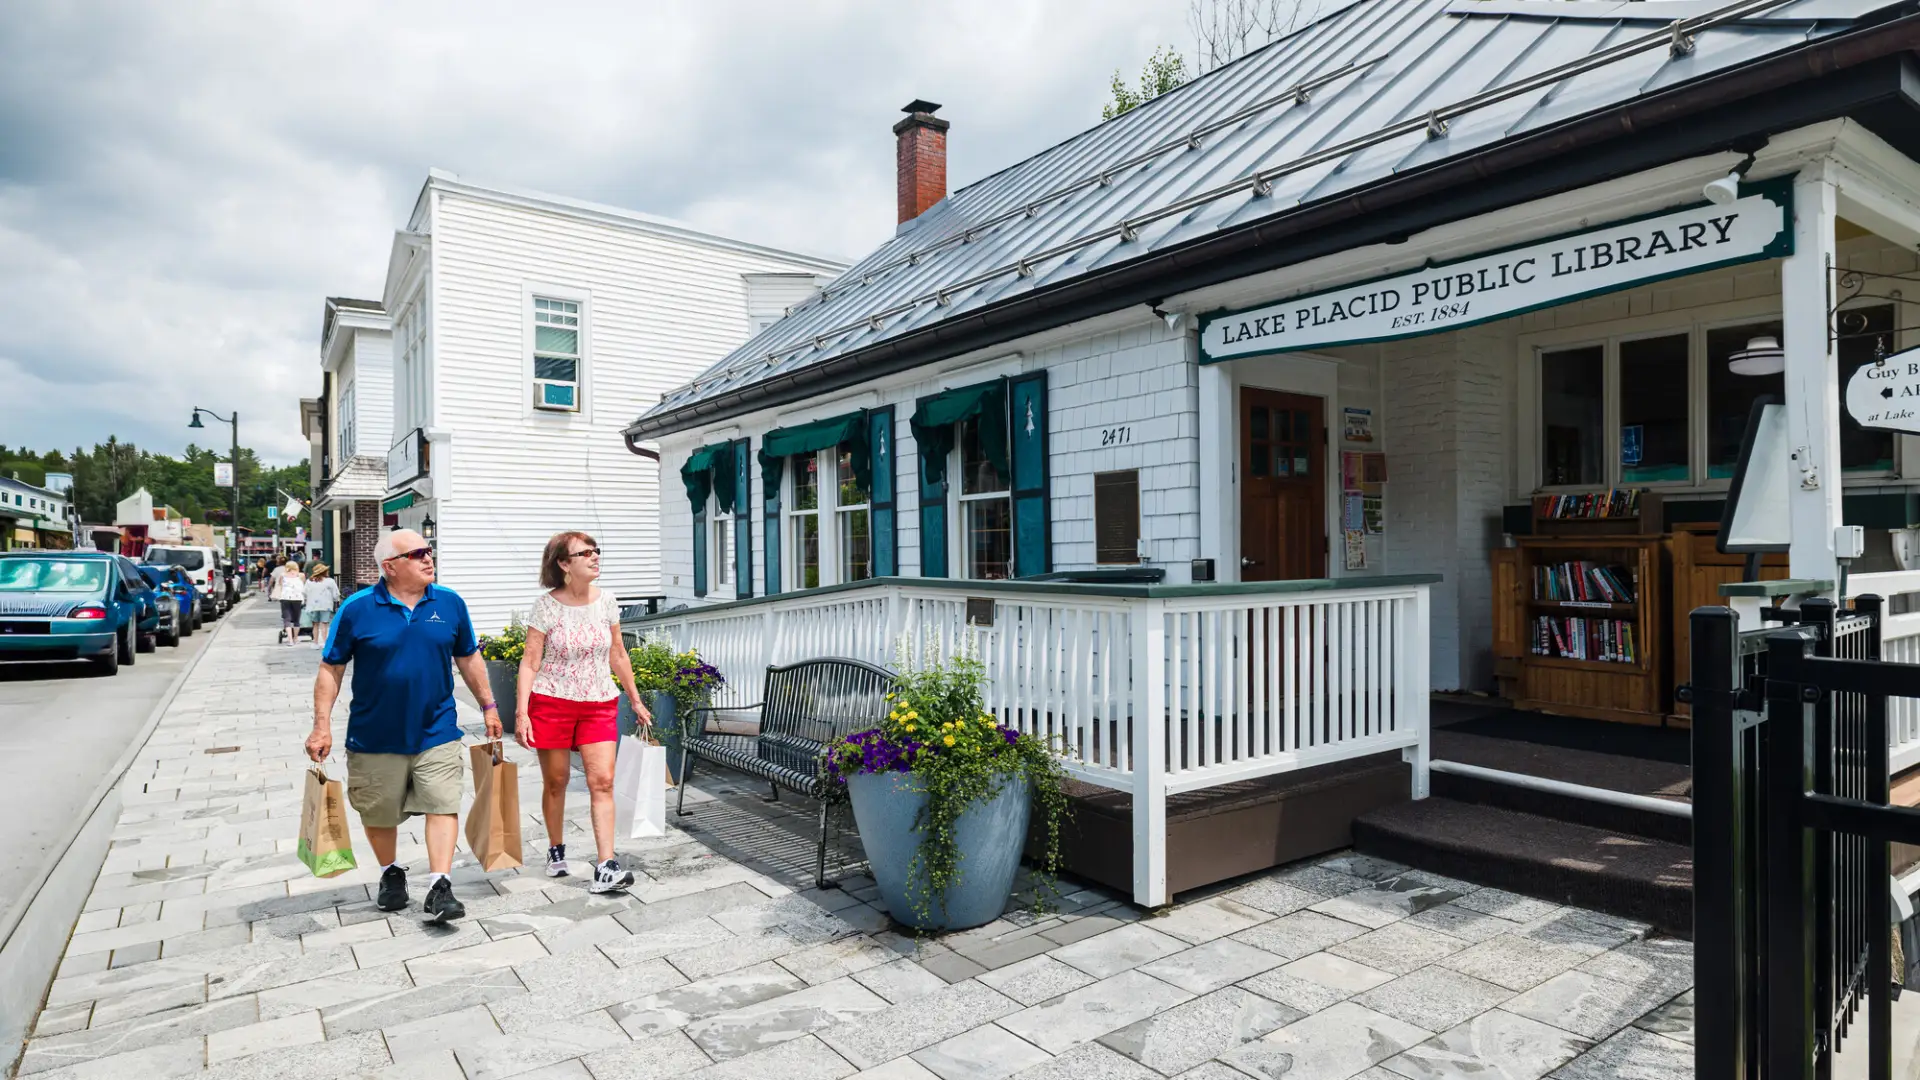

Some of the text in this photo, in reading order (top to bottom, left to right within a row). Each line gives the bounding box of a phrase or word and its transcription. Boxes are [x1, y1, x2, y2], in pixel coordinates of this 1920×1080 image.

[1222, 213, 1739, 345] LAKE PLACID PUBLIC LIBRARY
[1390, 301, 1470, 329] EST. 1884
[1866, 367, 1900, 380] Guy
[1867, 408, 1915, 422] at Lake
[1102, 426, 1131, 447] 2471
